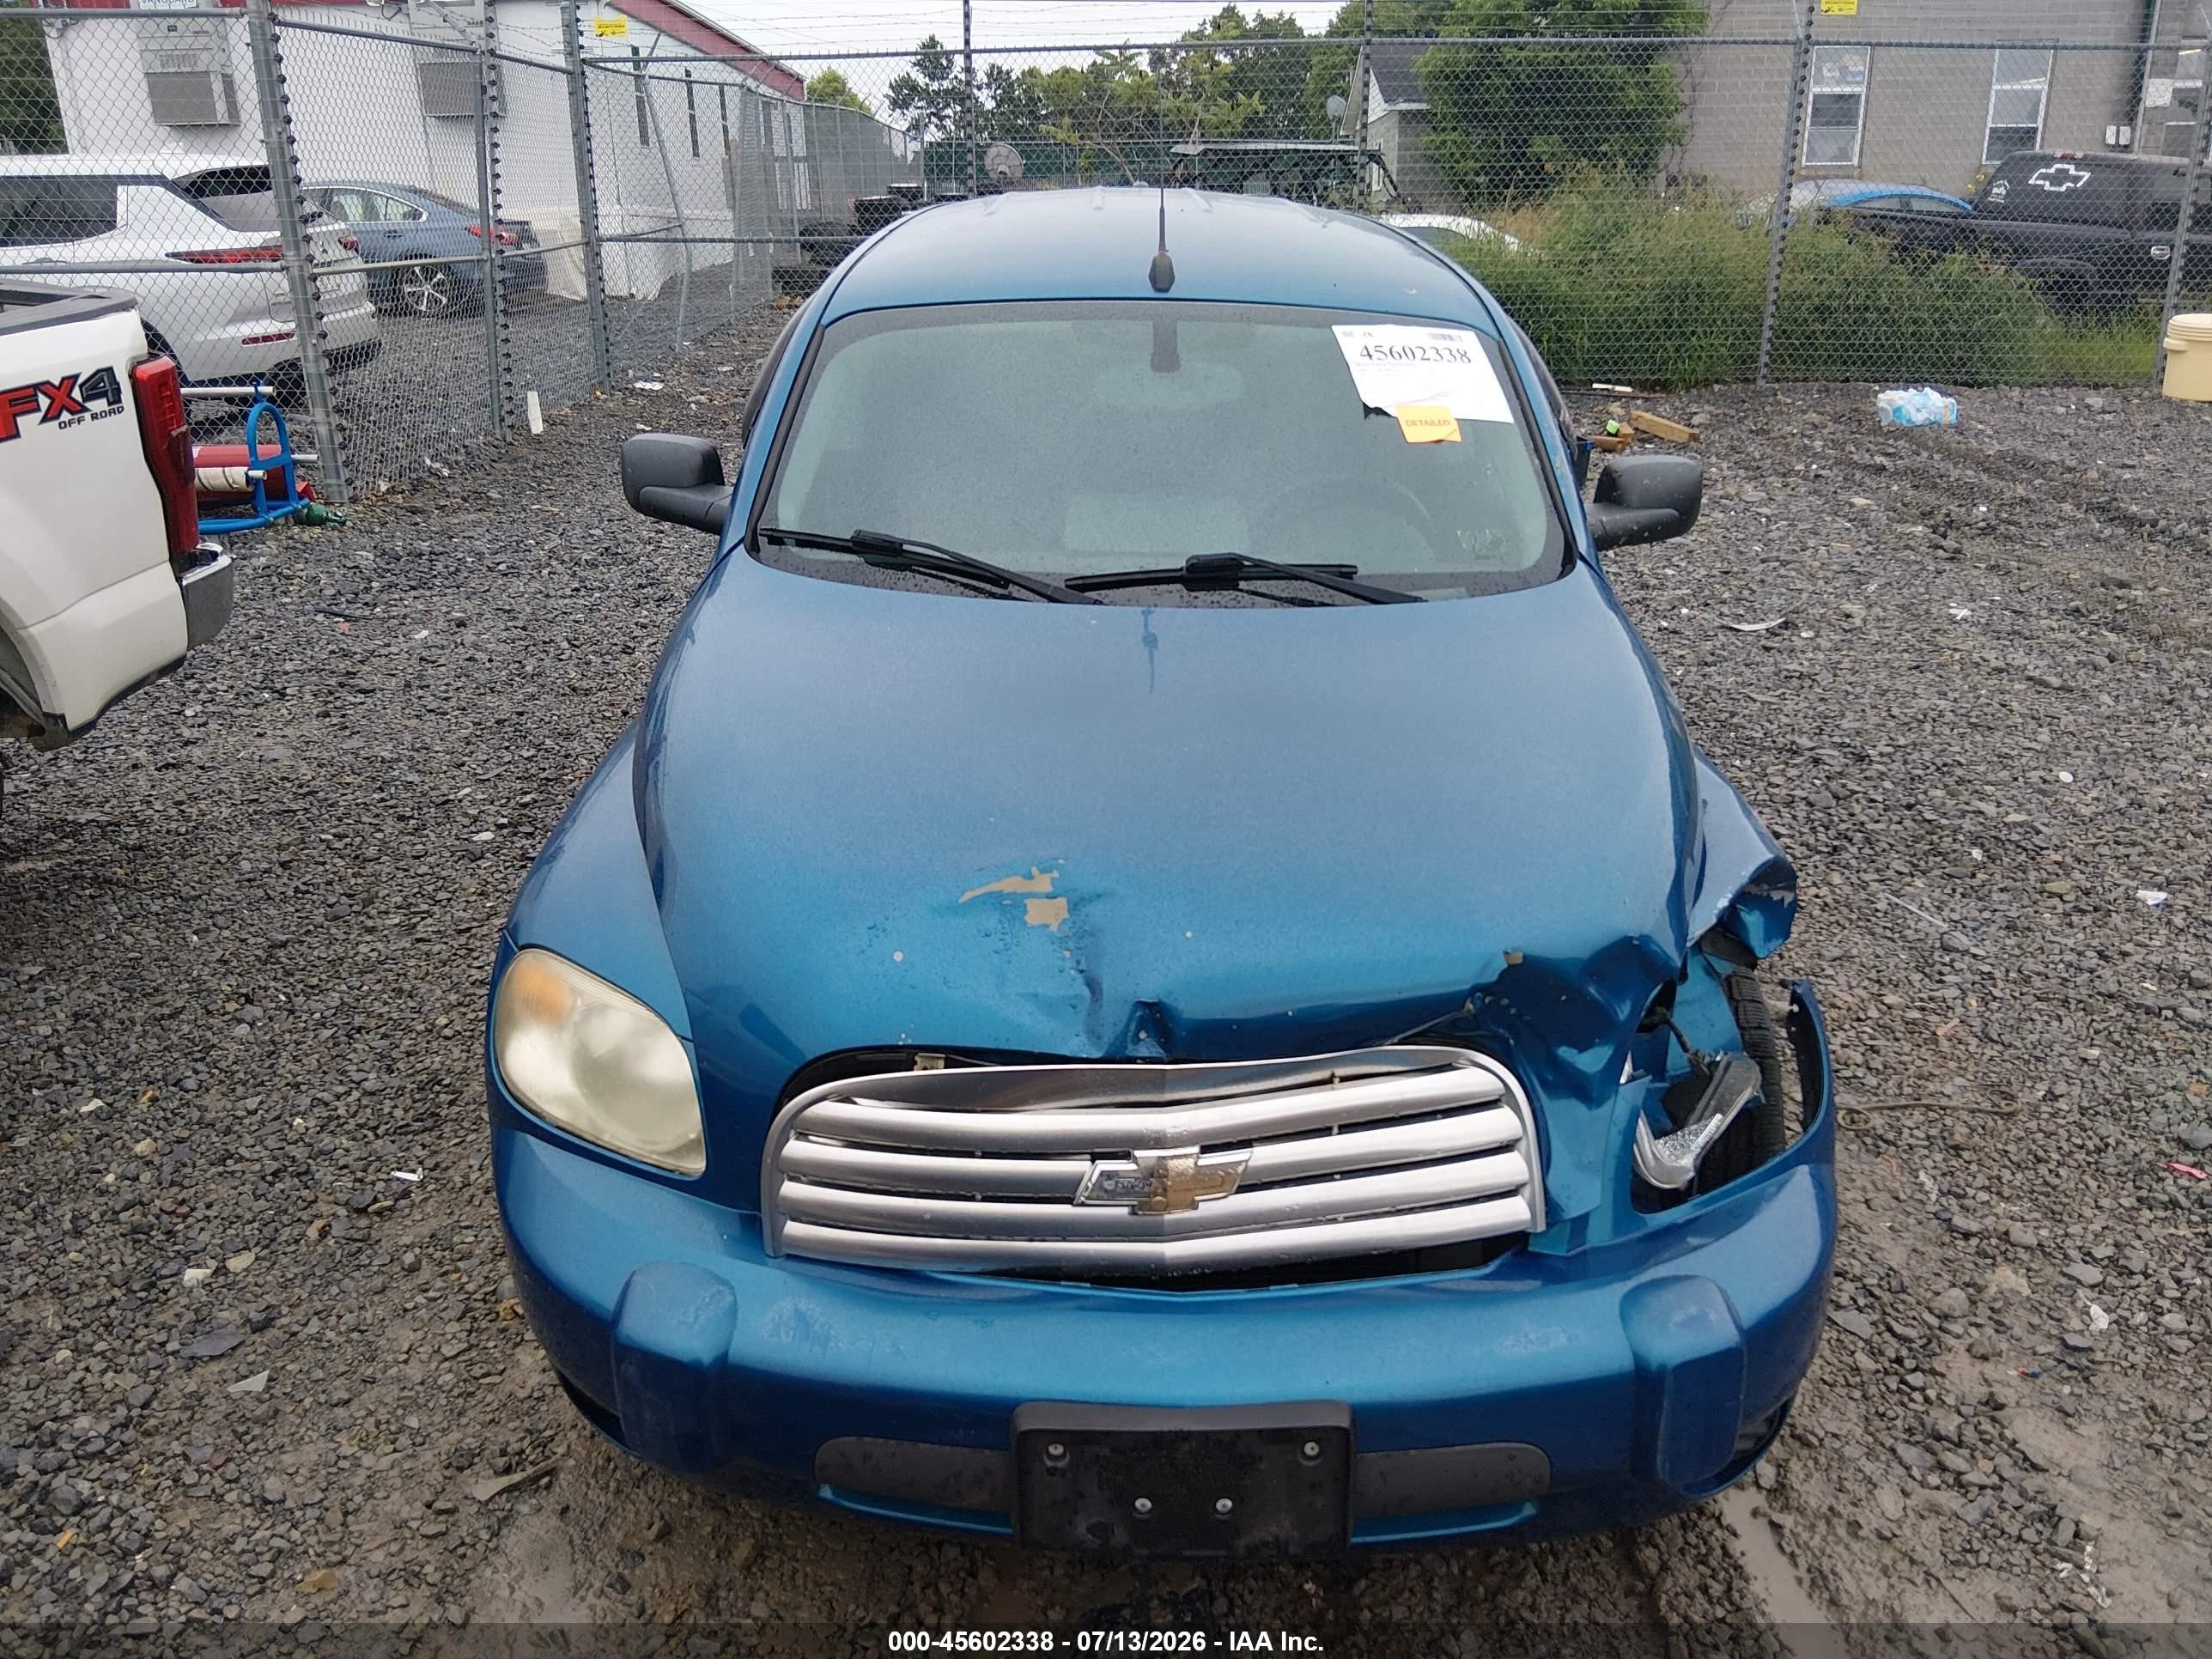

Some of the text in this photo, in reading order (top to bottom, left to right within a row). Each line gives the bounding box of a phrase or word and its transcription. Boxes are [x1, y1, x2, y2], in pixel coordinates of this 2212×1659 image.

[1360, 344, 1472, 364] 45602338
[0, 365, 123, 443] FX4
[58, 405, 125, 430] OFF ROAD
